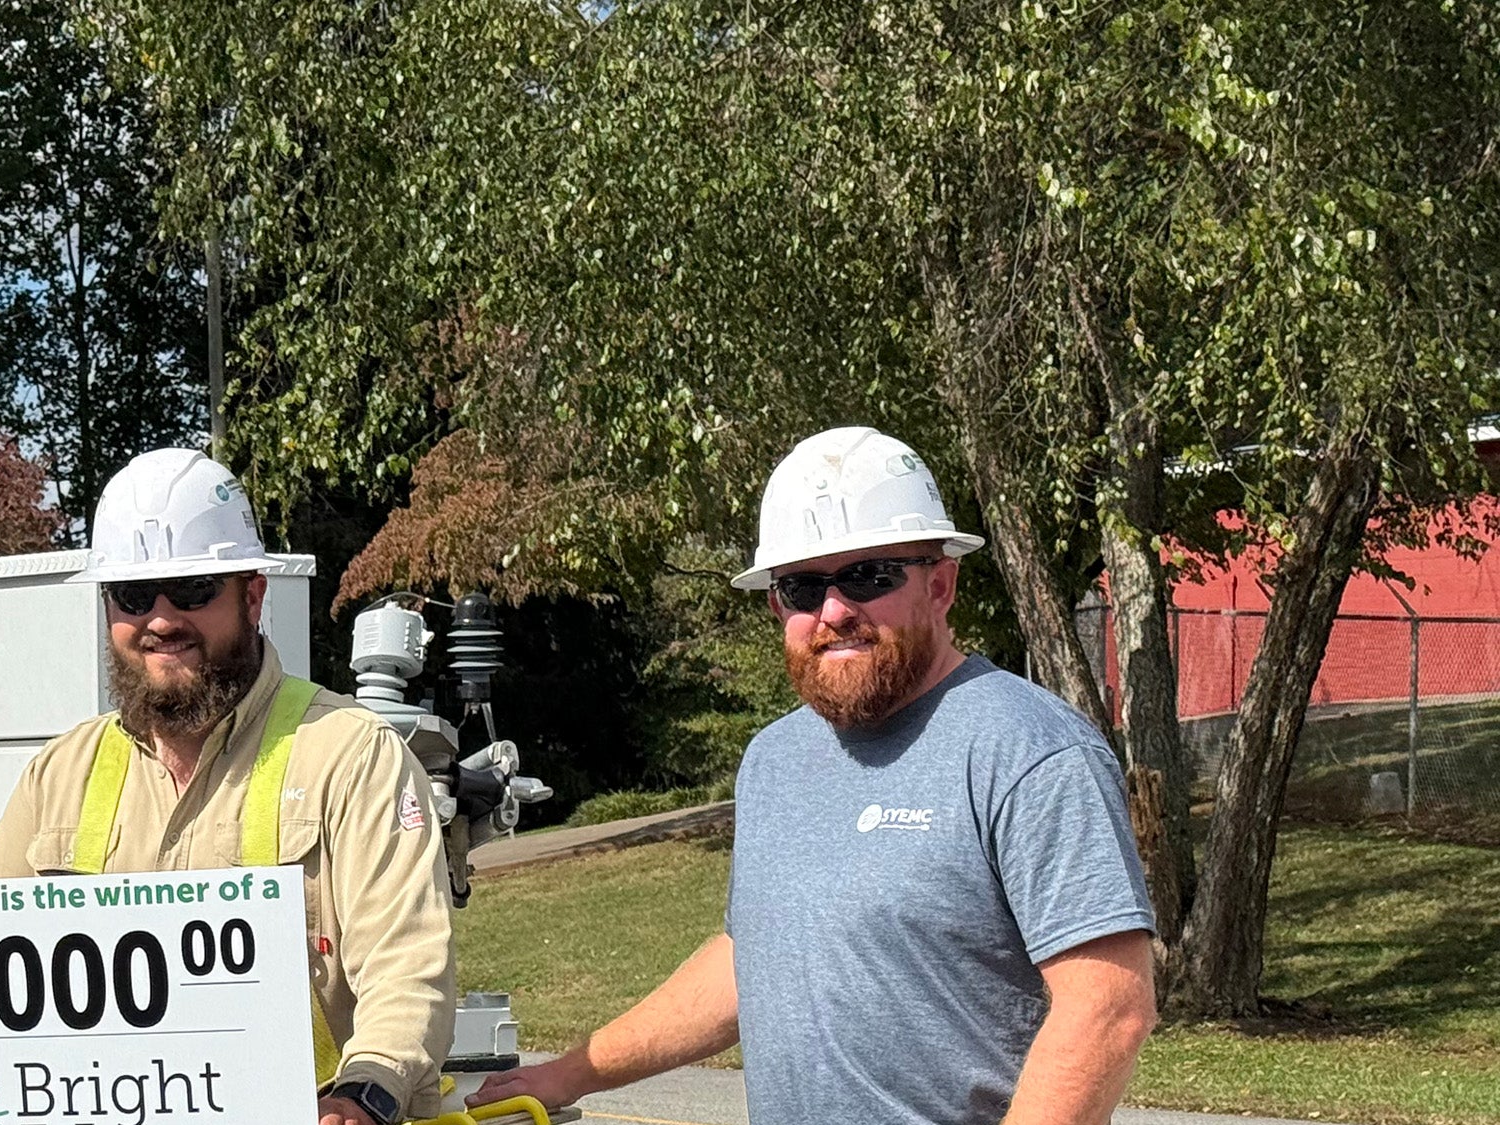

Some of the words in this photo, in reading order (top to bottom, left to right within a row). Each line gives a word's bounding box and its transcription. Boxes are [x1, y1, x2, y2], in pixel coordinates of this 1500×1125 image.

[881, 808, 934, 823] SYEMC
[0, 884, 24, 911] is
[33, 883, 86, 910] the
[93, 878, 210, 907] winner
[218, 874, 253, 902] of
[262, 879, 281, 900] a
